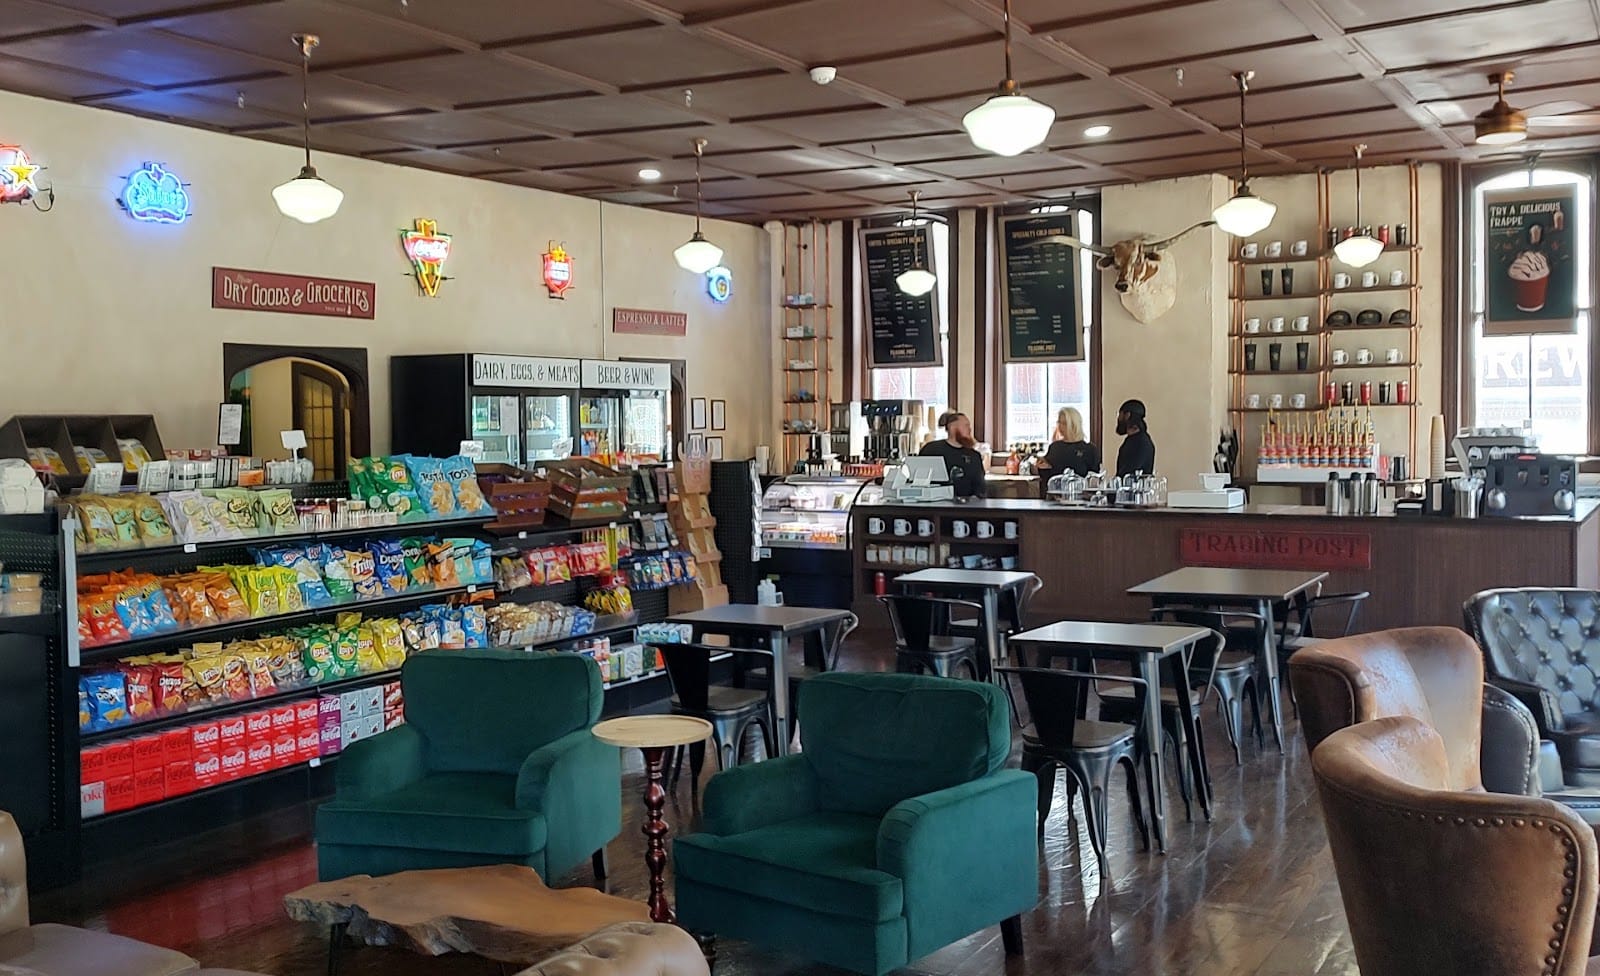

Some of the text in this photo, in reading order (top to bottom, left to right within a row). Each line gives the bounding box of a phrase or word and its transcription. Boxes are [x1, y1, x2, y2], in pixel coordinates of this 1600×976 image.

[1490, 201, 1561, 217] TRY A DELICIOUS
[1490, 216, 1523, 228] FRAPPE
[224, 276, 248, 304] DRY
[252, 283, 290, 306] GOODS
[291, 288, 304, 307] &
[307, 281, 369, 312] GROCERIES
[617, 311, 652, 325] ESPRESSO
[661, 314, 685, 327] LATTES
[475, 360, 579, 383] DAIRY, EGGS, & MEATS
[598, 365, 655, 386] BEER & WINE
[1190, 531, 1360, 558] TRADING POST
